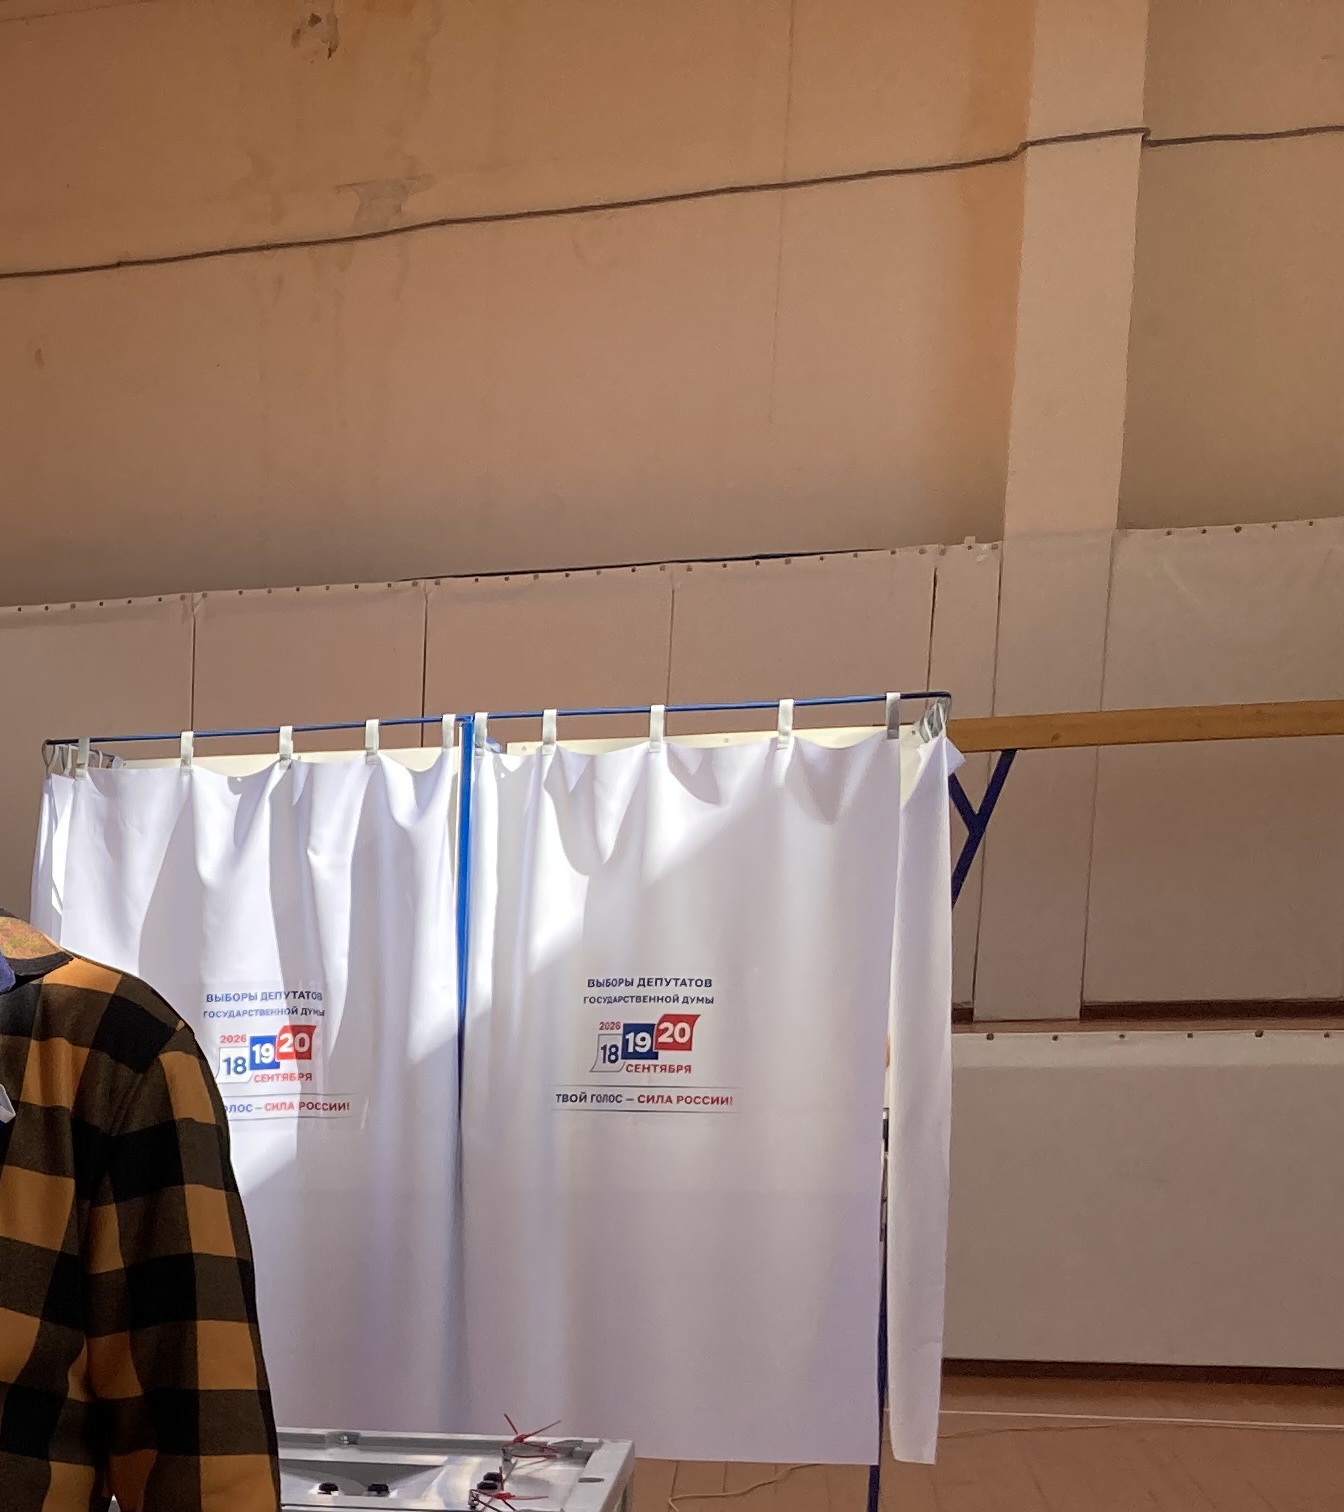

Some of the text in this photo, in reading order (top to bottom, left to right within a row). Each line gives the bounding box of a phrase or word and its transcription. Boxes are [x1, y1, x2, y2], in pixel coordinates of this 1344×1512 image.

[587, 977, 712, 988] ВЫБОРЫ ДЕПУТАТОВ
[206, 990, 323, 1003] ВЫБОРЫ ДЕПУТАТОВ
[583, 993, 714, 1005] ГОСУДАРСТВЕННОЙ ДУМЫ
[203, 1006, 325, 1018] ГОСУДАРСТВЕННОЙ ДУМЫ
[599, 1021, 621, 1031] 2026
[219, 1034, 247, 1044] 2026
[657, 1022, 691, 1044] 20
[278, 1032, 310, 1053] 20
[625, 1032, 652, 1053] 19
[252, 1043, 275, 1064] 19
[600, 1044, 619, 1064] 18
[222, 1056, 247, 1076] 18
[625, 1063, 692, 1074] СЕНТЯБРЯ
[254, 1072, 312, 1084] СЕНТЯБРЯ
[556, 1092, 587, 1103] ТВОЙ
[590, 1093, 623, 1103] ГОЛОС
[637, 1094, 673, 1105] СИЛА
[676, 1095, 733, 1106] РОССИИ!
[225, 1103, 253, 1113] ЛОС
[264, 1102, 295, 1112] СИЛА
[299, 1101, 350, 1112] РОССИИ!
